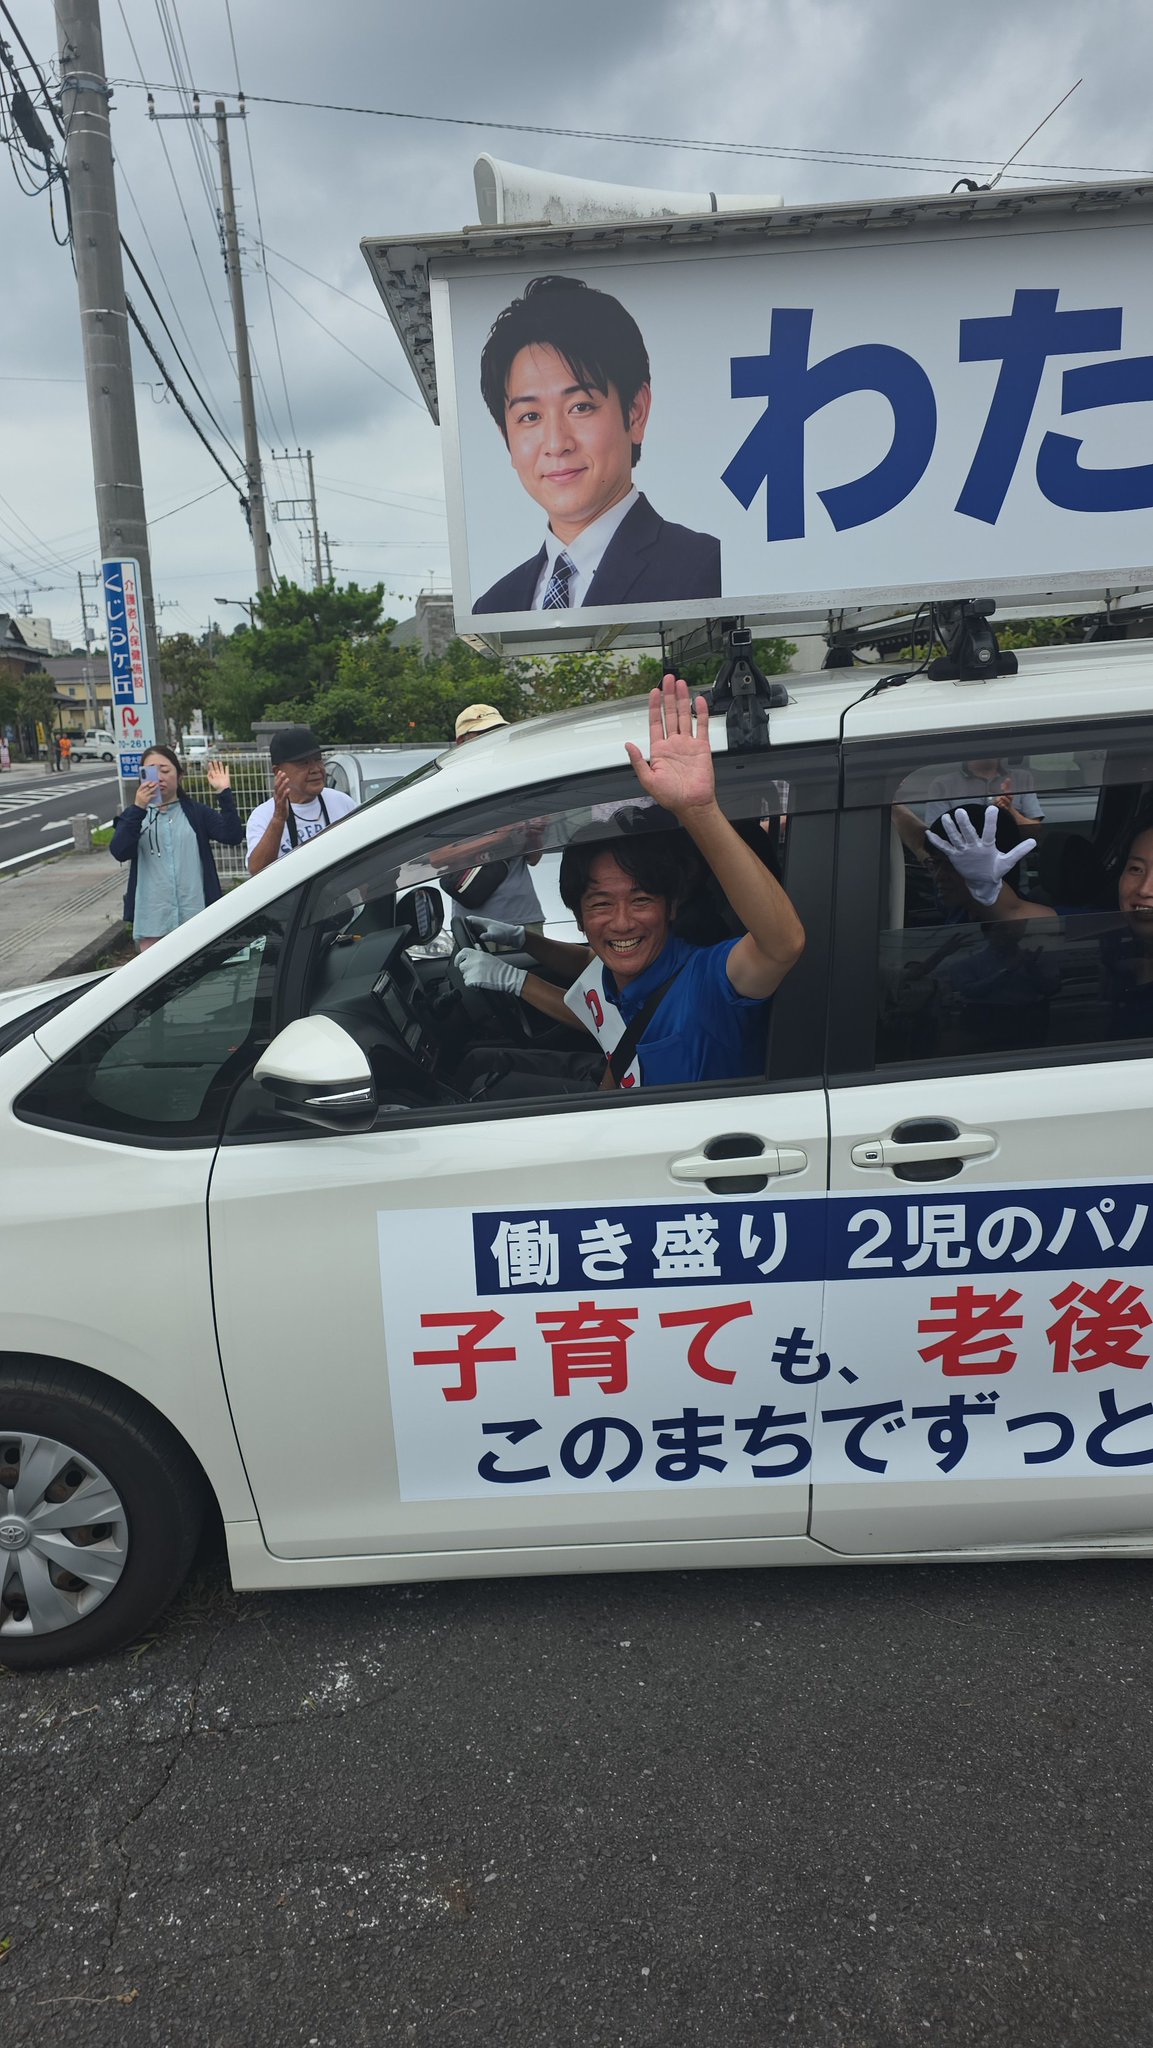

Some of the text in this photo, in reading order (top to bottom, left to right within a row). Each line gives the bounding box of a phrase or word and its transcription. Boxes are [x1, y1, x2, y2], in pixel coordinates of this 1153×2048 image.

[721, 289, 1153, 542] わた
[124, 579, 144, 688] 介護老人保健施設
[490, 1211, 787, 1287] 働き盛り
[918, 1279, 1153, 1377] 老後
[478, 1389, 1153, 1484] このまちでずっと
